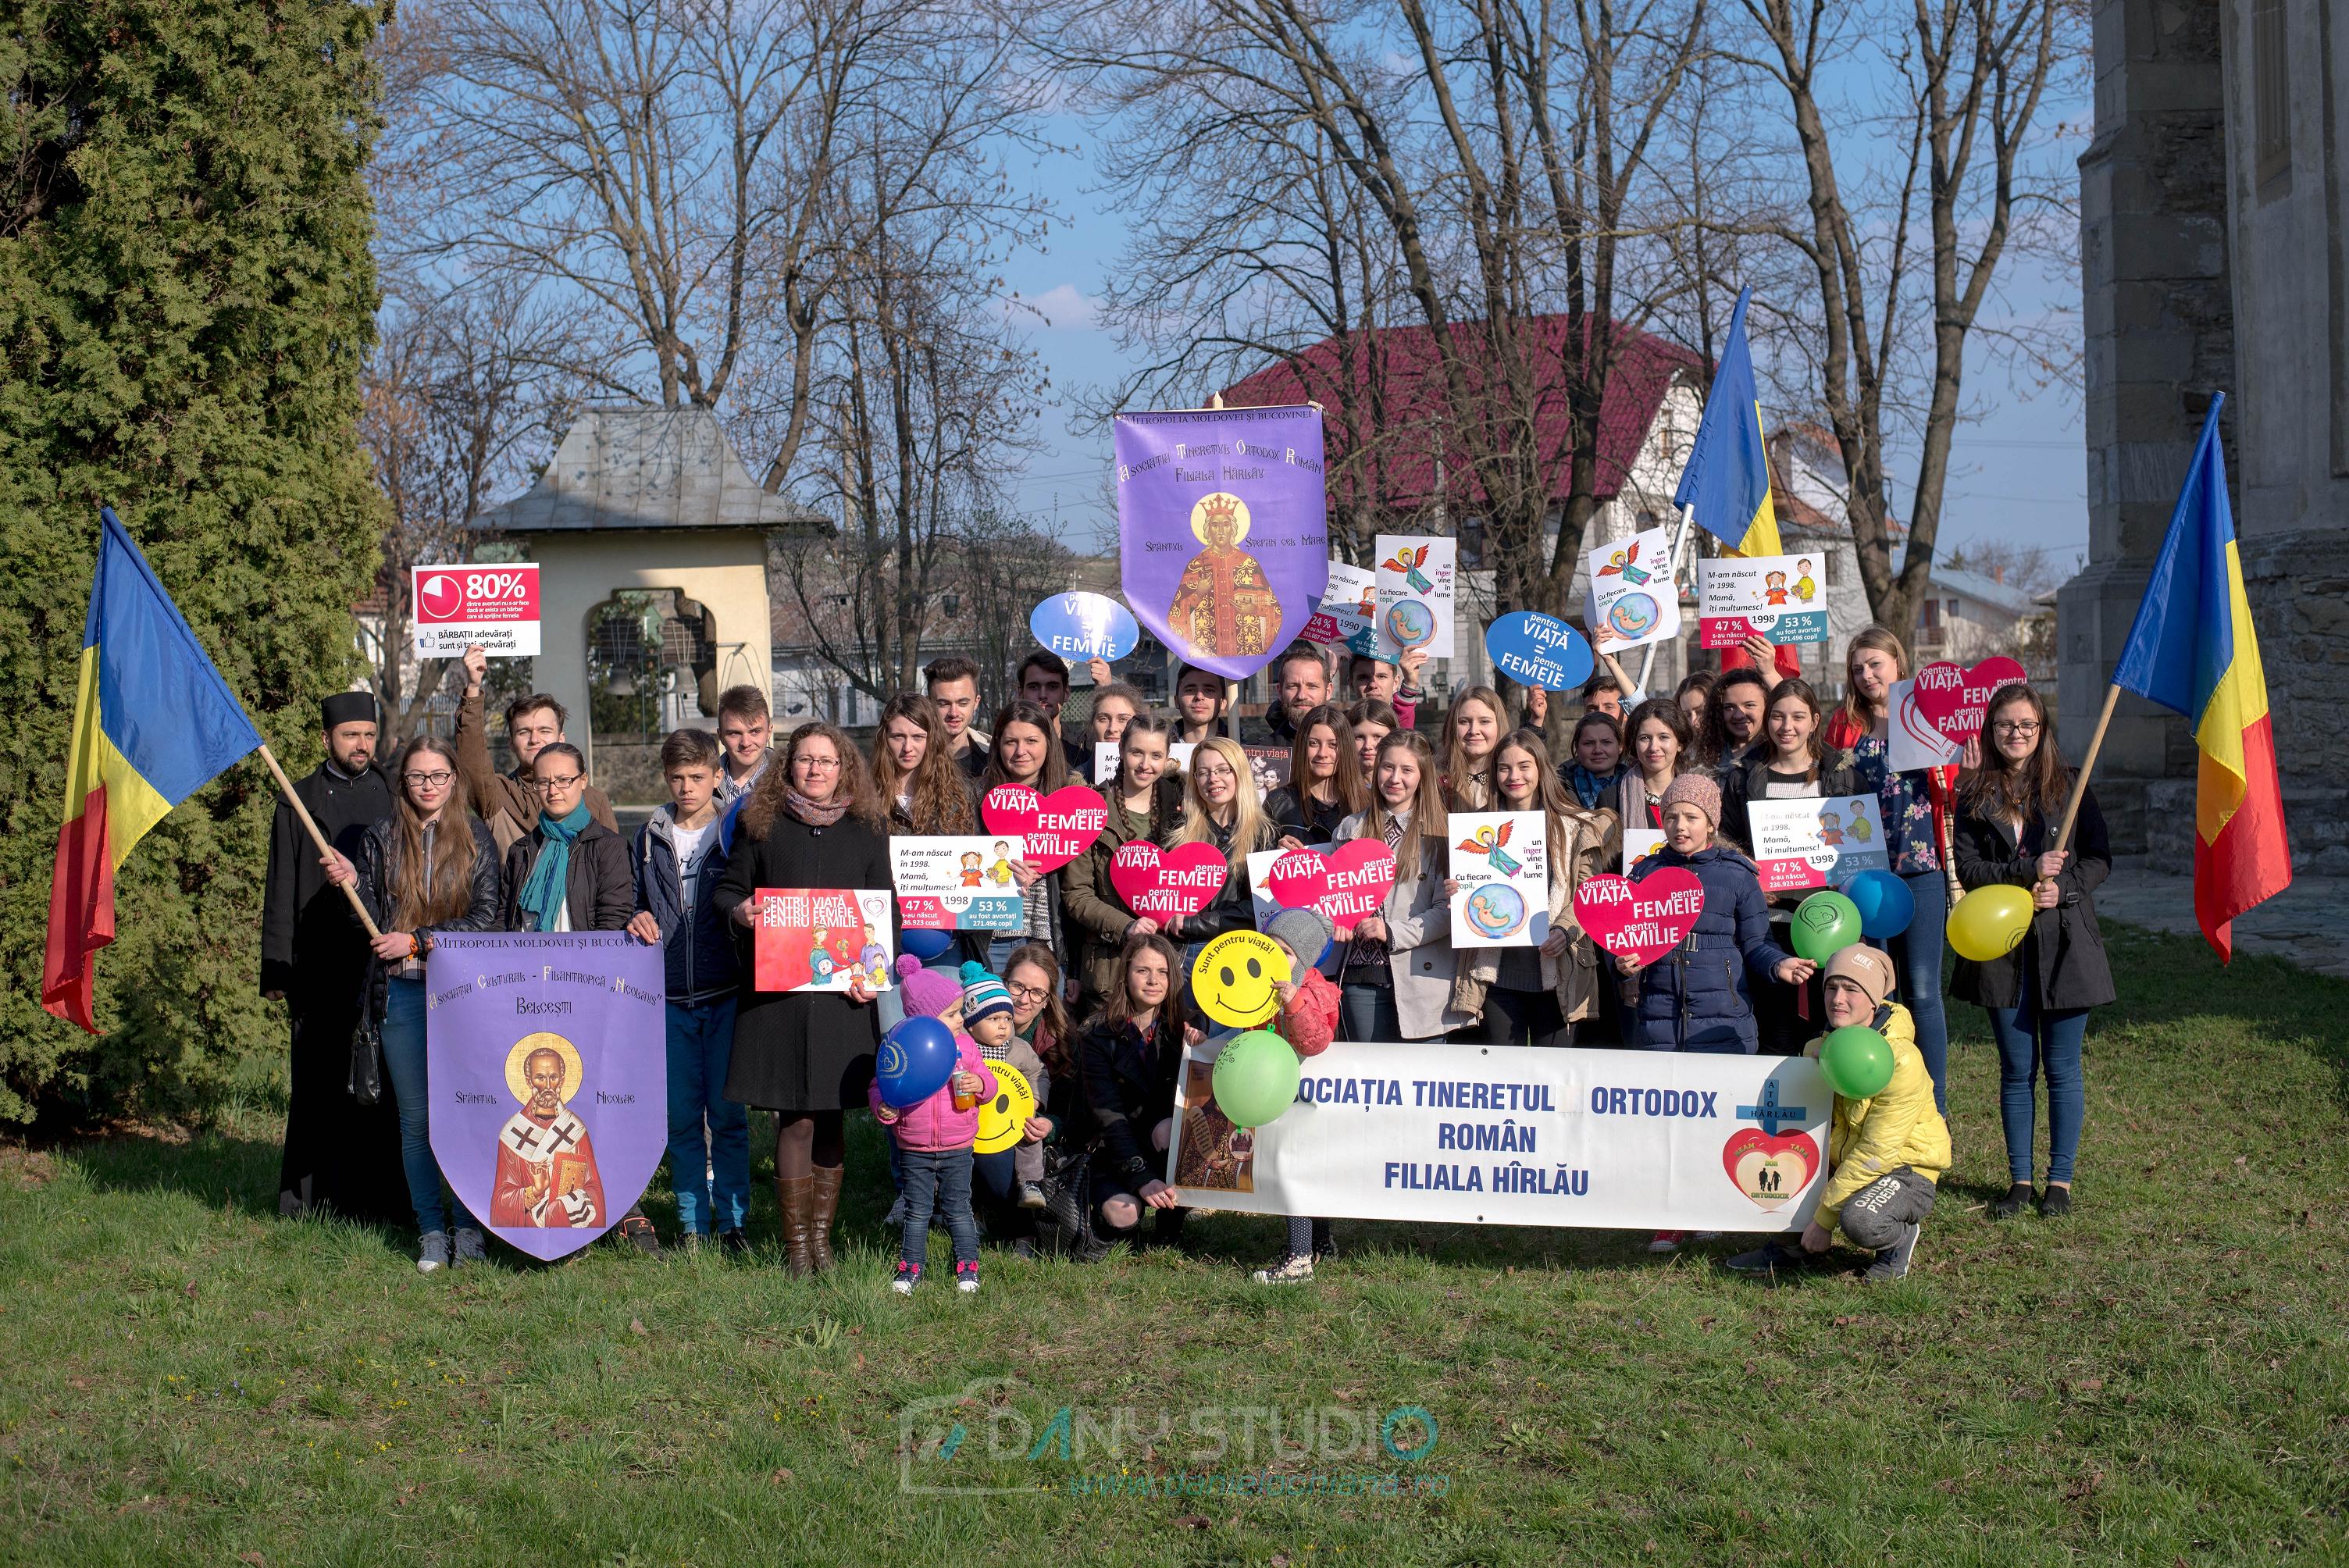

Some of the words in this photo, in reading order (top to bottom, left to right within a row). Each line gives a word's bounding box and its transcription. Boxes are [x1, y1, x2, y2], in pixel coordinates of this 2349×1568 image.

[1126, 416, 1188, 425] MITROPOLIA
[1259, 410, 1312, 419] BUCOVINEI
[466, 573, 526, 599] 80%
[1606, 587, 1627, 598] fiecare
[1312, 616, 1322, 625] 24
[1339, 619, 1359, 630] 1990
[1531, 615, 1559, 629] pentru
[1716, 622, 1729, 631] 47
[1732, 621, 1741, 630] %
[1785, 618, 1798, 627] 53
[1802, 616, 1812, 625] %
[439, 630, 472, 640] BĂRBAȚII
[475, 630, 512, 639] adevărați
[1367, 632, 1378, 642] 76
[1524, 620, 1570, 650] VIAȚĂ
[1798, 626, 1820, 635] avortați
[1501, 652, 1564, 688] FEMEIE
[1534, 656, 1563, 671] pentru
[1923, 666, 1951, 676] pentru
[1919, 668, 1964, 692] VIAȚĂ
[1997, 677, 2027, 689] pentru
[1964, 686, 1997, 704] FEM
[1955, 707, 1984, 718] pentru
[1267, 749, 1288, 758] viață
[993, 788, 1025, 796] pentru
[989, 792, 1039, 814] VIAȚĂ
[1076, 808, 1107, 817] pentru
[1039, 814, 1103, 830] FEMEIE
[1028, 832, 1060, 841] pentru
[1023, 839, 1079, 855] AMILIE
[1120, 845, 1148, 853] pentru
[1116, 849, 1160, 871] VIAȚĂ
[1273, 853, 1326, 879] VIAȚĂ
[1277, 853, 1309, 868] pentru
[1363, 857, 1396, 870] pentru
[1810, 855, 1834, 864] 1998
[1845, 857, 1859, 867] 53
[1196, 864, 1227, 873] pentru
[1773, 863, 1786, 873] 47
[1159, 870, 1222, 886] FEMEIE
[1327, 865, 1394, 889] FEMEIE
[1583, 878, 1616, 891] pentru
[1149, 889, 1178, 897] pentru
[1320, 891, 1353, 904] pentru
[1578, 880, 1633, 906] VIAȚĂ
[1671, 889, 1704, 901] pentru
[906, 900, 920, 911] 47
[924, 900, 934, 911] %
[978, 902, 993, 911] 53
[996, 901, 1007, 911] %
[1133, 896, 1198, 912] FAMILIE
[1301, 895, 1376, 917] AMILIE
[1634, 896, 1701, 918] FEMEIE
[764, 907, 809, 917] PENTRU
[814, 907, 854, 918] FEMEIE
[764, 917, 809, 927] PENTRU
[814, 917, 857, 927] FAMILIE
[1624, 921, 1658, 934] pentru
[434, 937, 509, 949] MITROPOLIA
[514, 939, 573, 947] MOLDOVEI
[1606, 927, 1679, 950] FAMILIE
[1199, 953, 1214, 974] Sunt
[1214, 936, 1245, 954] pentru
[1248, 936, 1274, 954] viață!
[1854, 953, 1874, 969] NIKE
[1011, 1074, 1029, 1100] viață!
[1293, 1078, 1403, 1113] OCIAȚIA
[1413, 1081, 1555, 1112] TINERETUL
[1592, 1086, 1717, 1118] ORTODOX
[1439, 1118, 1536, 1153] ROMÂN
[1385, 1162, 1483, 1192] FILIALA
[1492, 1160, 1588, 1196] HÎRLĂU
